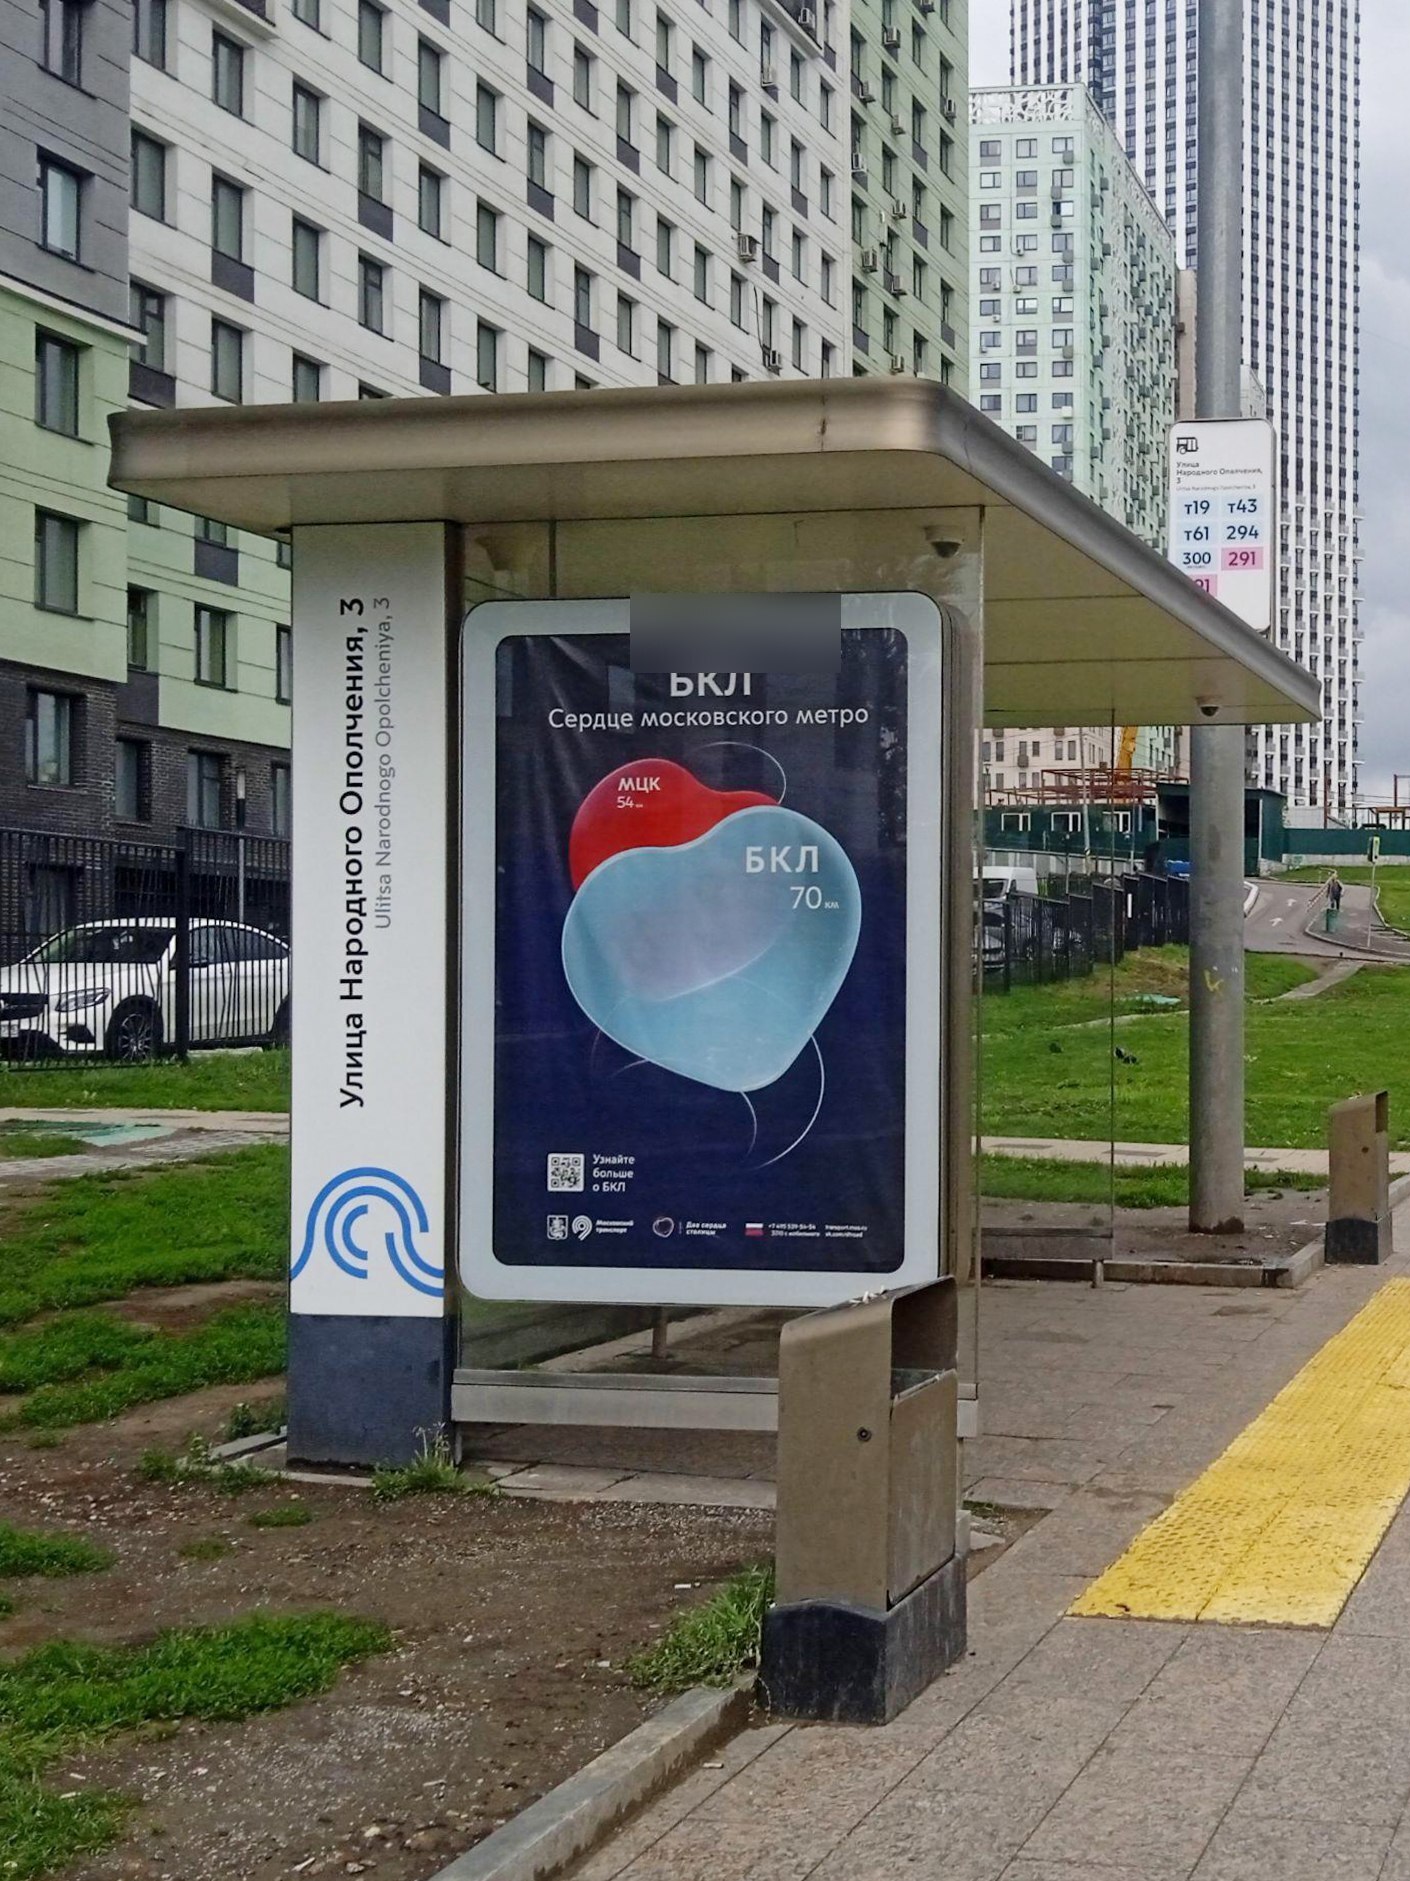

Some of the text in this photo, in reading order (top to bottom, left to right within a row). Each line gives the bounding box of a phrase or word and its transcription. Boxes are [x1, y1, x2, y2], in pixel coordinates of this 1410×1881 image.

[1226, 525, 1259, 540] 294
[1183, 552, 1211, 565] 300
[1228, 551, 1256, 566] 291
[548, 708, 869, 733] Сердце московского метро
[373, 597, 395, 928] Ulitsa Narodnogo Opolcheniya, 3
[618, 776, 661, 793] МЦК
[616, 796, 635, 809] 54
[339, 598, 368, 1108] Улица Народного Ополчения, 3
[746, 846, 818, 873] БКЛ
[790, 886, 822, 910] 70
[592, 1154, 636, 1165] Узнайте
[592, 1167, 634, 1179] больше
[592, 1182, 626, 1192] о БКЛ
